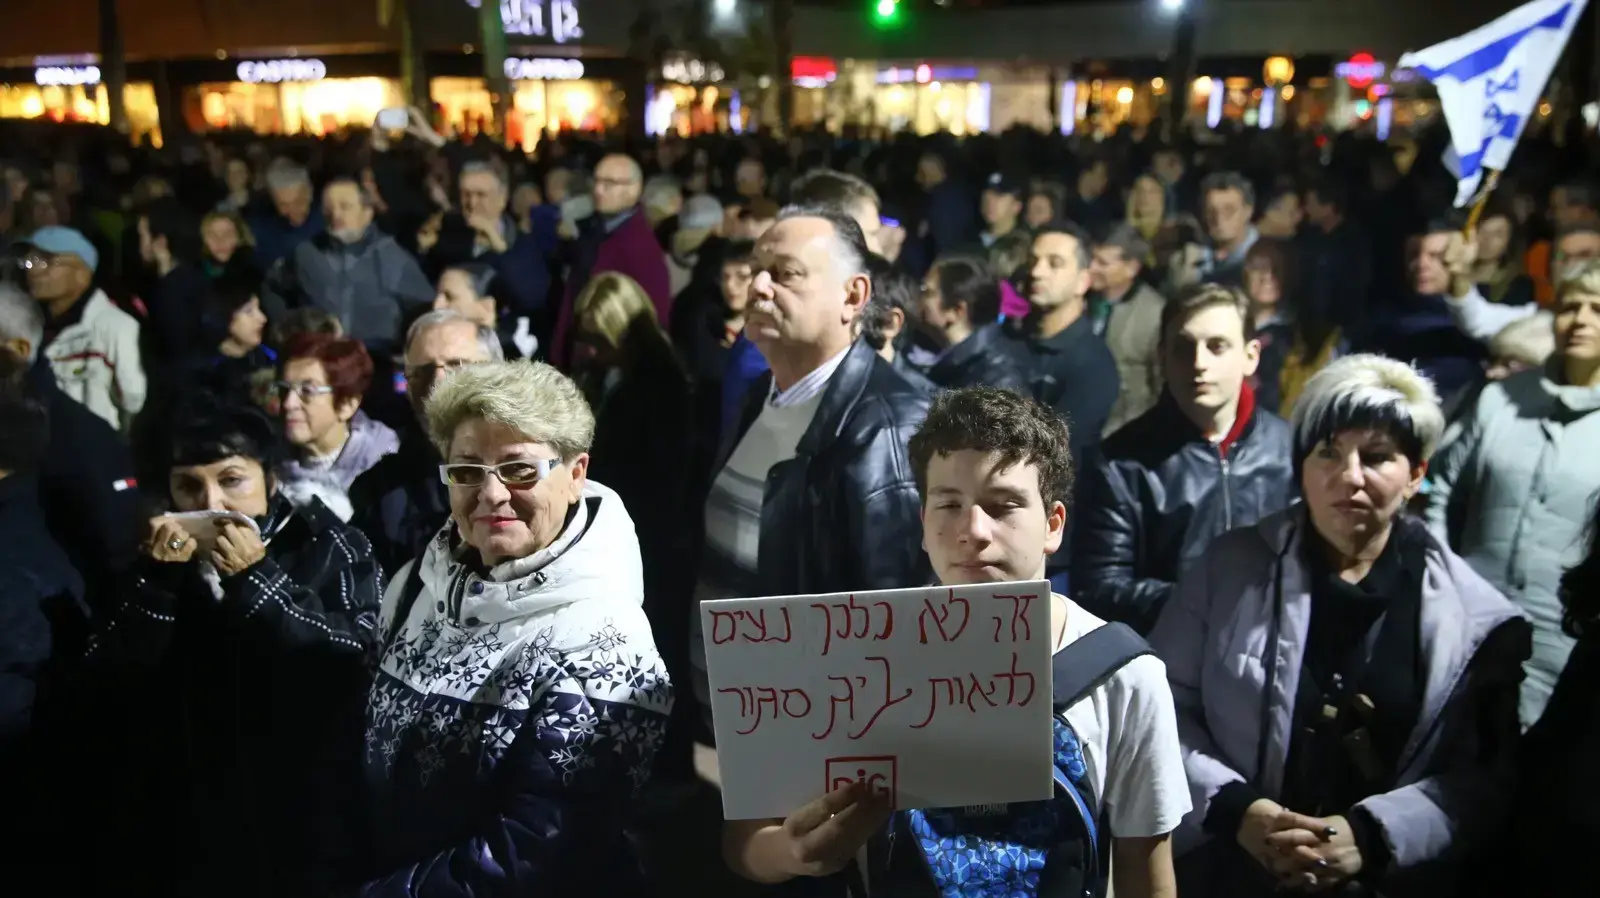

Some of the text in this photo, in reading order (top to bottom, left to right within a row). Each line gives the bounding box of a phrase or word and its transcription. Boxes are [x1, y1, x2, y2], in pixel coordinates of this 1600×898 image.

[918, 588, 970, 644] לא
[992, 594, 1038, 642] זה
[909, 652, 1036, 728] לראות
